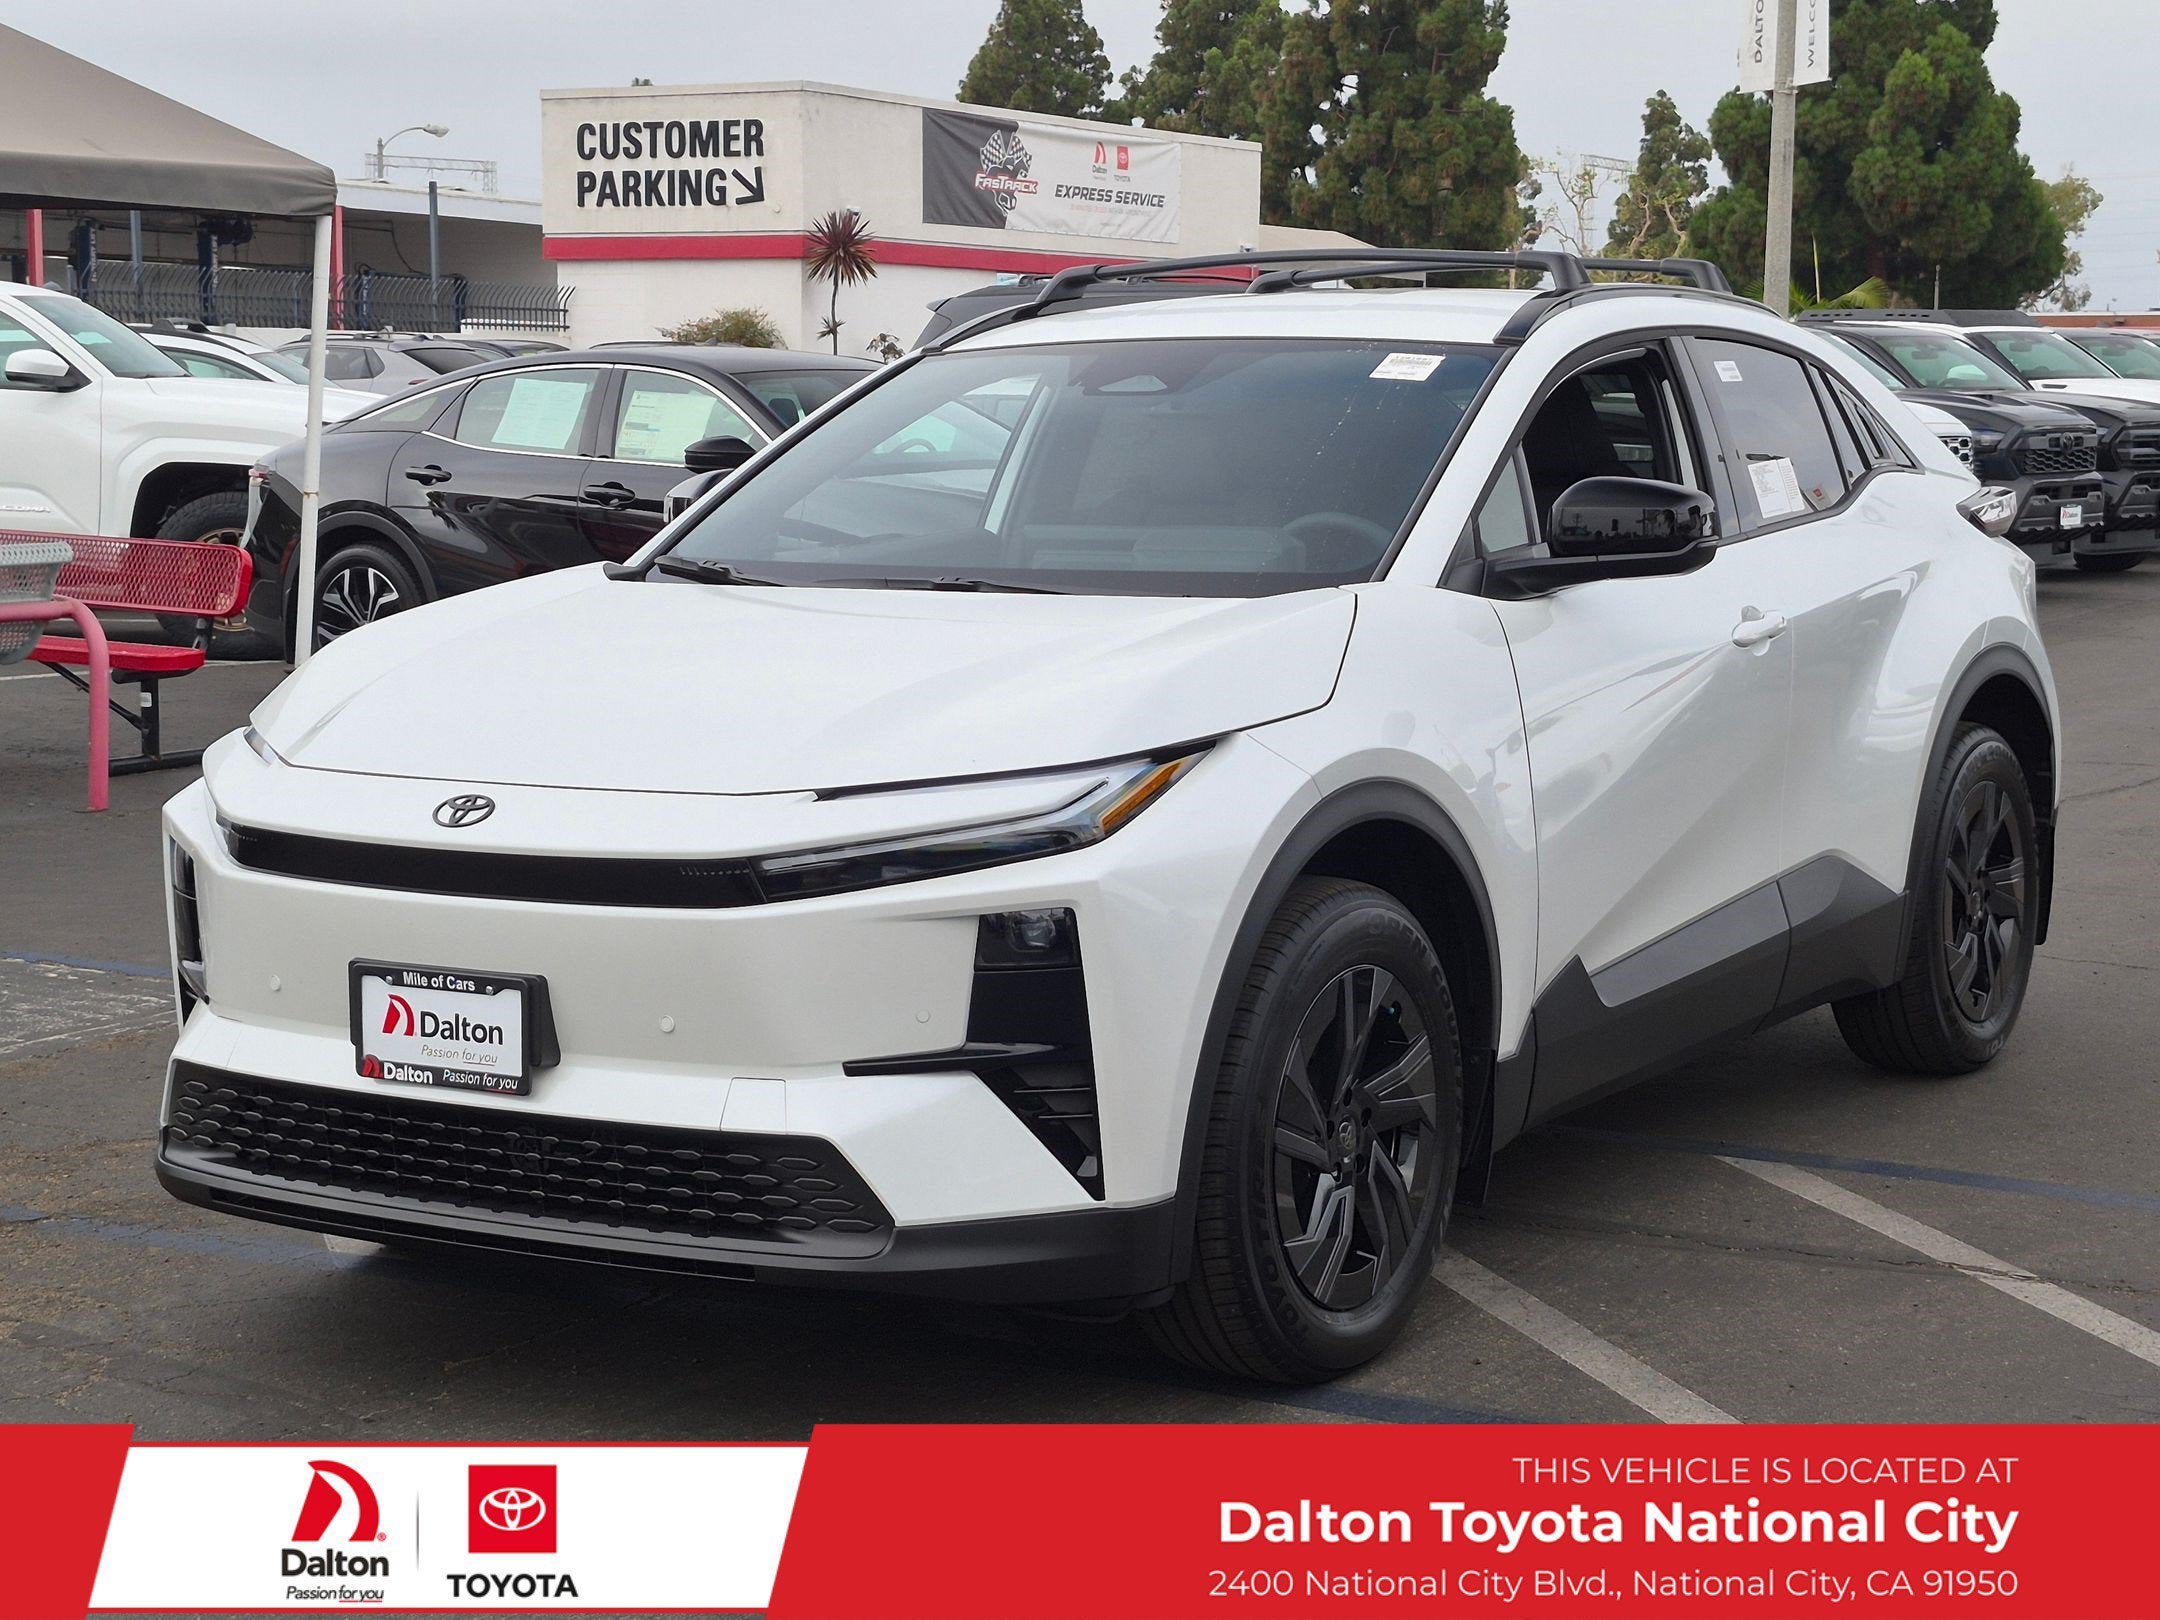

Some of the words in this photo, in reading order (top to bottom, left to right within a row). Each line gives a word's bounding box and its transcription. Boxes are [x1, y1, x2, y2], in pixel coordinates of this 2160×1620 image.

[1754, 0, 1765, 63] DALTO
[577, 119, 764, 160] CUSTOMER
[577, 168, 727, 207] PARKING
[1055, 184, 1113, 203] EXPRESS
[1115, 190, 1165, 208] SERVICE
[403, 972, 428, 987] Mile
[431, 974, 444, 988] of
[446, 977, 476, 992] Cars
[420, 1010, 504, 1045] Dalton
[421, 1044, 459, 1059] Passion
[462, 1048, 476, 1061] for
[479, 1053, 498, 1063] you
[383, 1062, 433, 1085] Dalton
[443, 1069, 480, 1085] Passion
[482, 1072, 498, 1086] for
[499, 1079, 518, 1090] you
